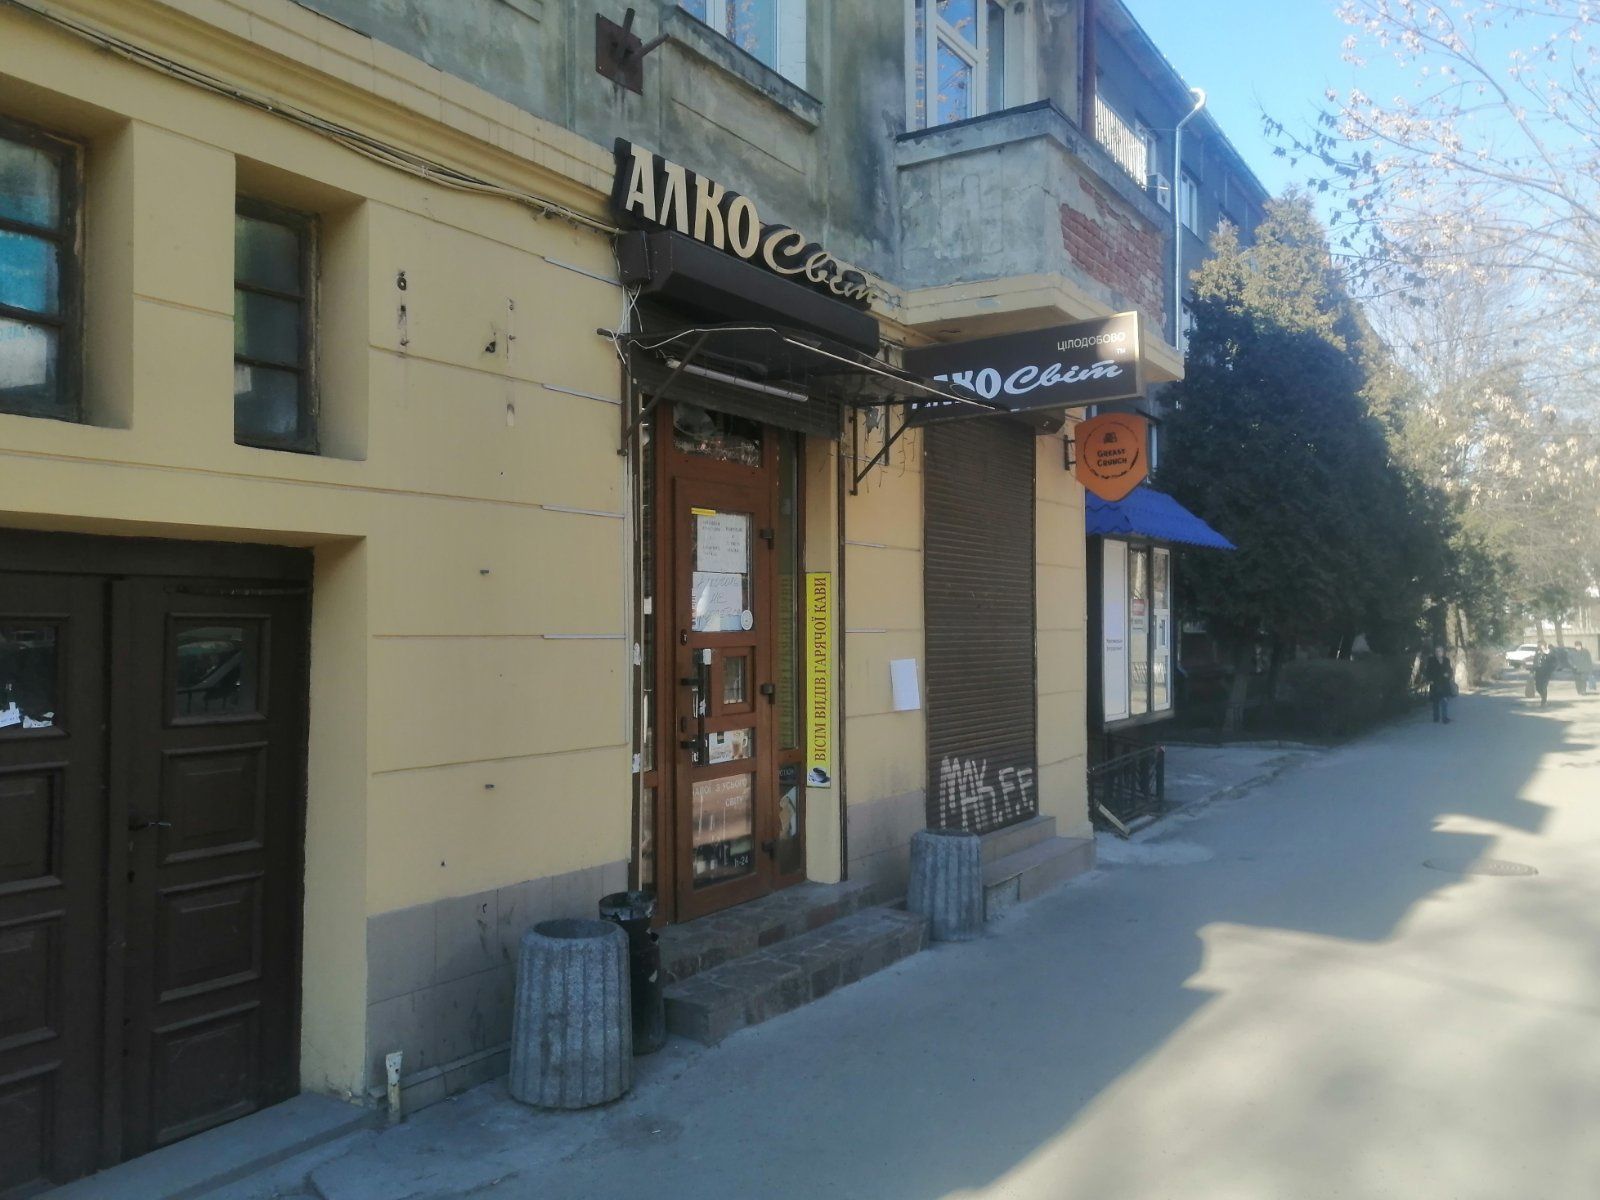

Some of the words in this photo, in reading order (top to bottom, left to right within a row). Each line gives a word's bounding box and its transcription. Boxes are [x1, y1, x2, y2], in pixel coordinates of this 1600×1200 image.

[1057, 331, 1127, 352] ЦІЛОДОБОВО
[814, 577, 827, 613] КАВИ
[811, 617, 827, 675] ГАРЯЧОЇ
[814, 677, 829, 722] ВИДІВ
[814, 726, 827, 761] ВІСІМ
